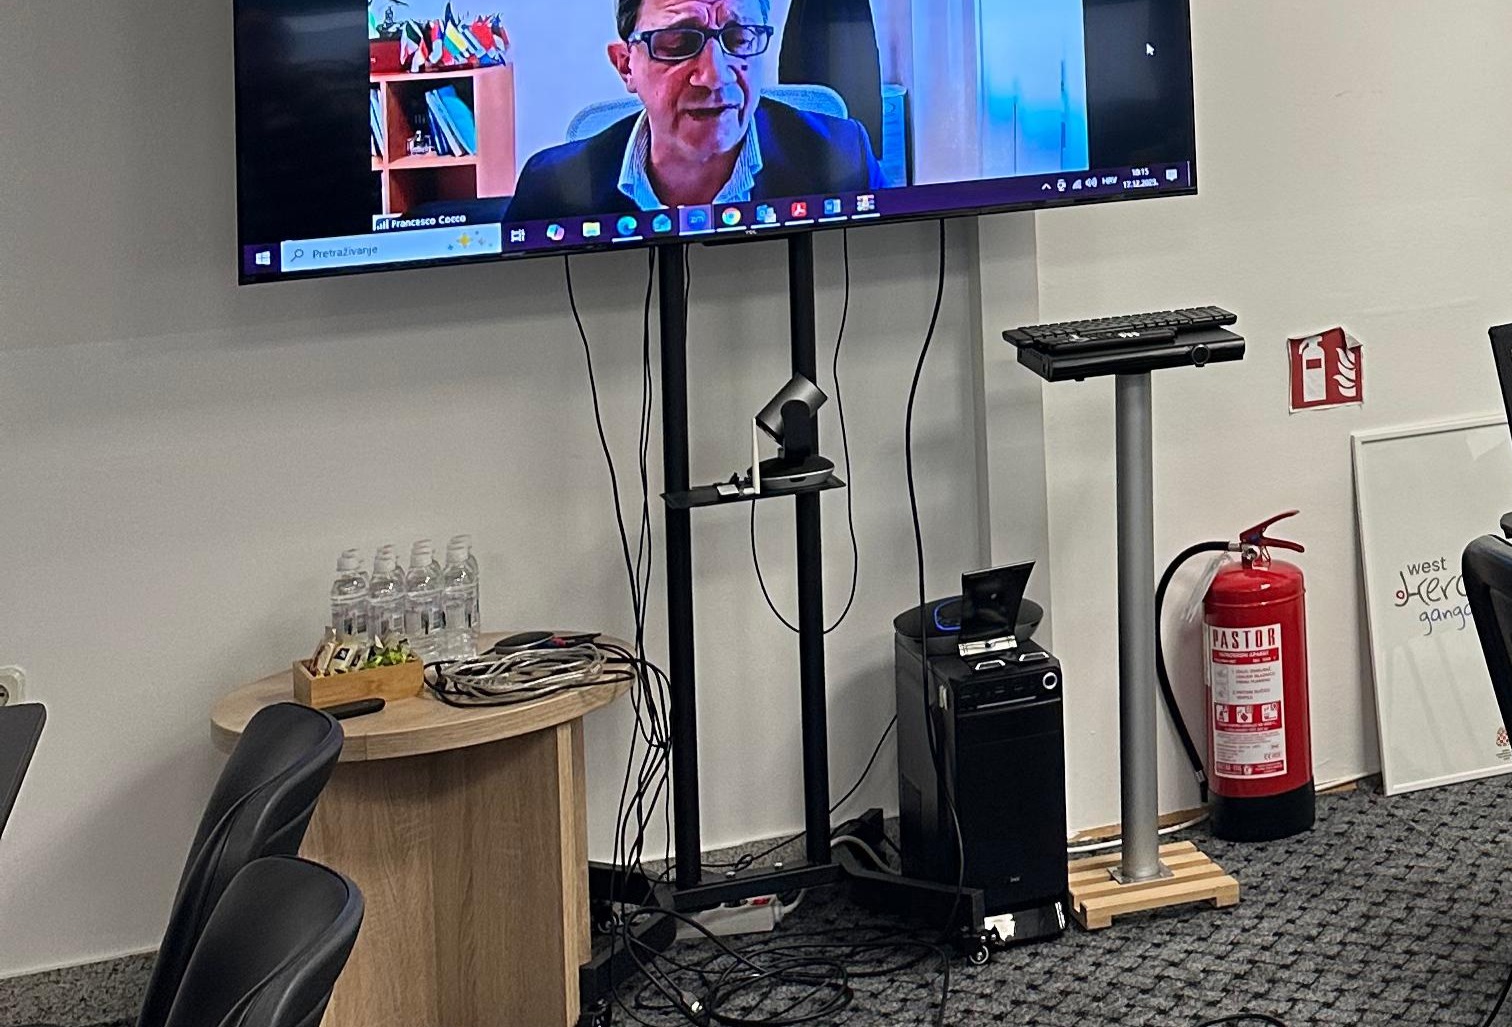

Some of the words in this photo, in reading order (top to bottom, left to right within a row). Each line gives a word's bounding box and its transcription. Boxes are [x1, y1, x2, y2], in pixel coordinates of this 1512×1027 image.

[391, 217, 436, 229] Francesco
[439, 214, 467, 224] Cocco
[1406, 557, 1447, 575] west
[1212, 627, 1275, 649] PASTOR
